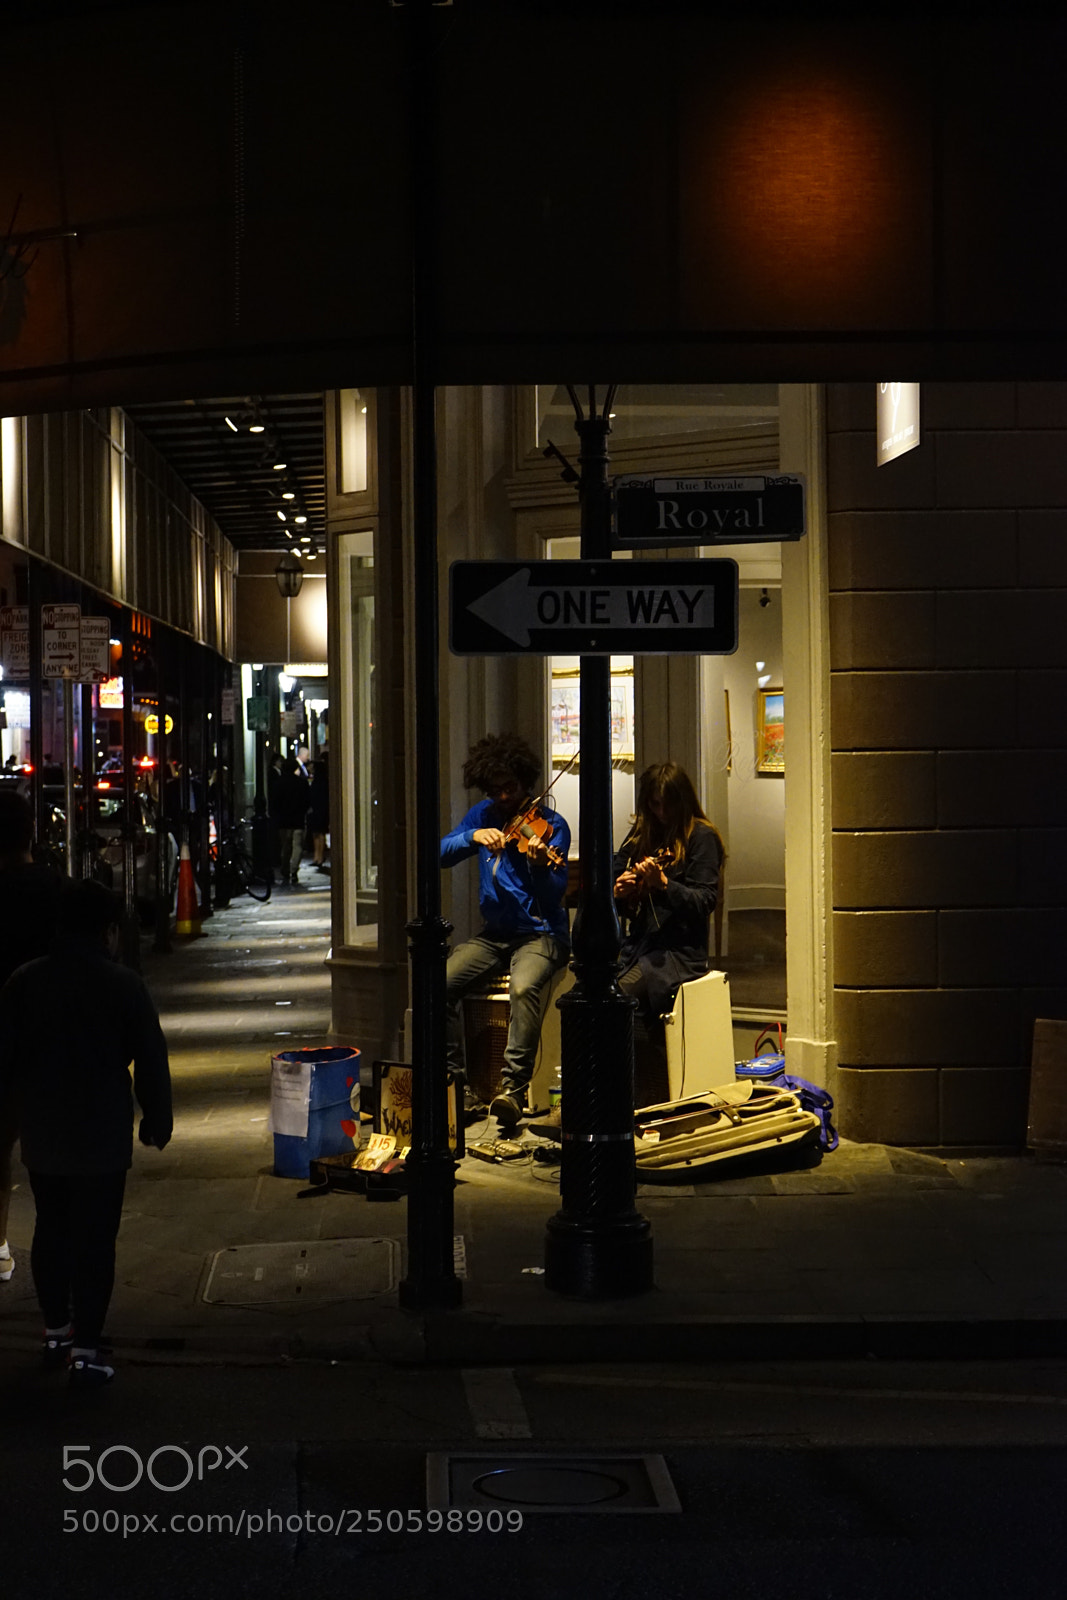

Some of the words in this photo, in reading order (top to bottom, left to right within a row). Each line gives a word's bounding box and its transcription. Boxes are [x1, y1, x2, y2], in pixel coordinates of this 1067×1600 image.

[676, 481, 698, 491] Rue
[704, 479, 745, 492] Royale
[656, 497, 767, 535] Royal
[537, 589, 611, 625] ONE
[626, 589, 705, 624] WAY
[43, 611, 54, 625] NO
[4, 632, 30, 642] FREIG
[57, 631, 67, 640] TO
[46, 641, 77, 651] CORNER
[46, 664, 79, 674] ANYME
